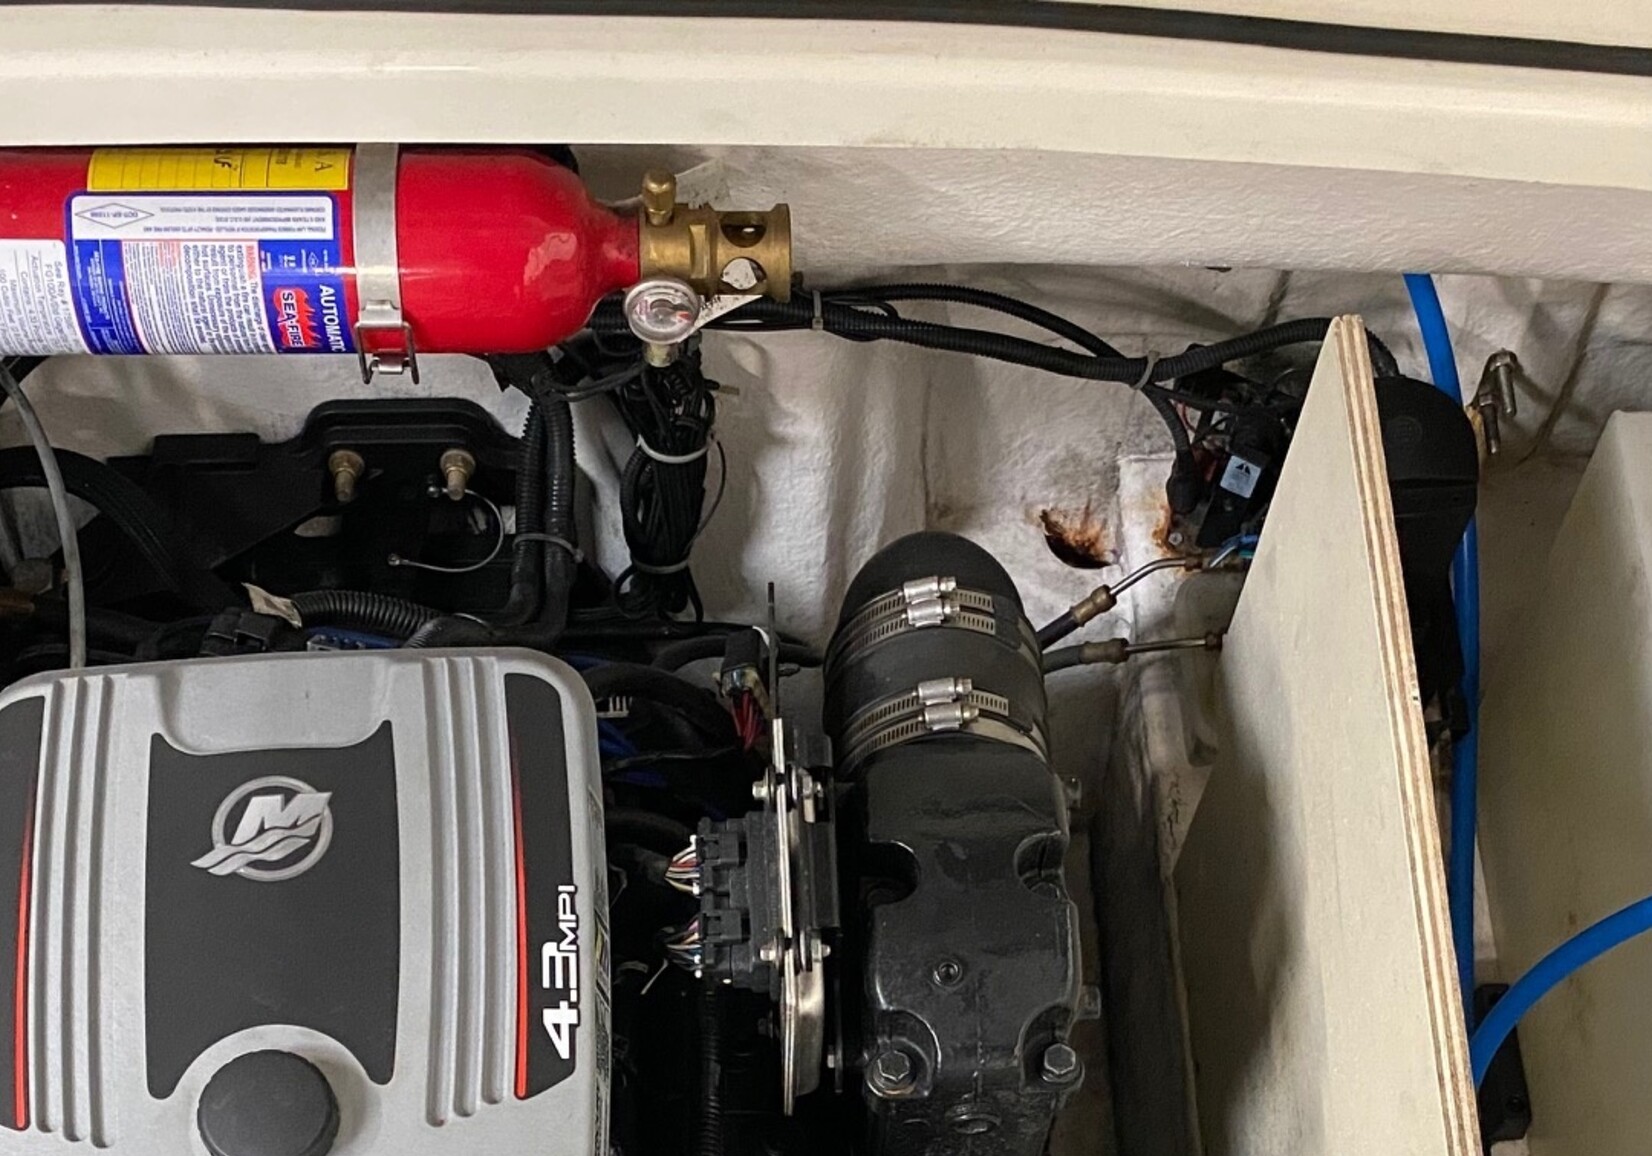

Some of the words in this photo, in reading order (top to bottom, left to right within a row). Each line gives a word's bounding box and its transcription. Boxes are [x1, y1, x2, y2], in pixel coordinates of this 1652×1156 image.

[201, 245, 209, 257] hot
[218, 245, 227, 266] agent
[221, 268, 227, 276] or
[228, 254, 238, 290] personnel
[237, 245, 246, 283] extinguish
[56, 281, 65, 298] Ray
[184, 245, 195, 299] decomposition
[191, 302, 200, 315] shall
[198, 291, 208, 314] natural
[215, 288, 225, 317] exposure
[200, 316, 211, 330] agent
[226, 309, 237, 332] products
[319, 285, 346, 351] AUTOMATIC
